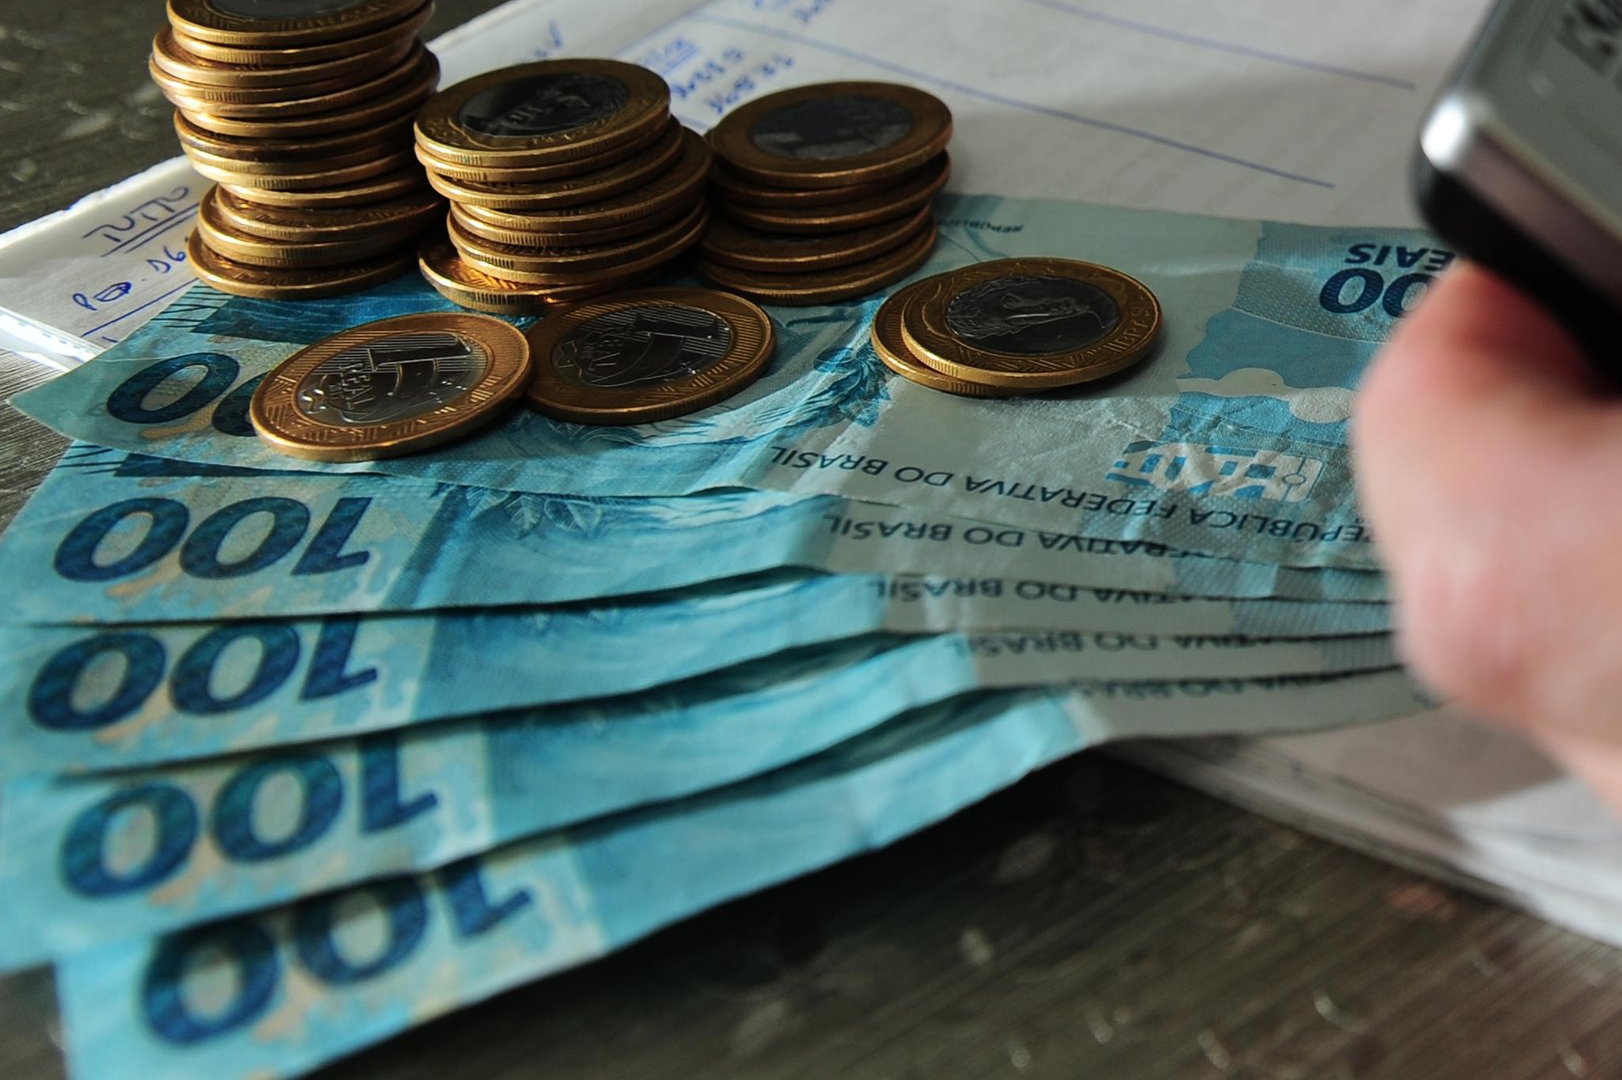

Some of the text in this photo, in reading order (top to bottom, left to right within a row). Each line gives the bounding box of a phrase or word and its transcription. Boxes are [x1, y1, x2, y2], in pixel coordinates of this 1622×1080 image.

[1344, 243, 1457, 272] EAIS
[1319, 267, 1438, 319] 00
[771, 446, 1372, 544] EPÚBLICA FEDERATIVA DO BRASIL
[52, 496, 372, 583] 100
[822, 514, 954, 542] BRASIL
[963, 526, 1024, 548] DO
[869, 576, 1002, 603] BRASIL
[1015, 580, 1077, 602] DO
[26, 613, 379, 732] 100
[58, 735, 439, 901] 100
[138, 868, 532, 1049] 100
